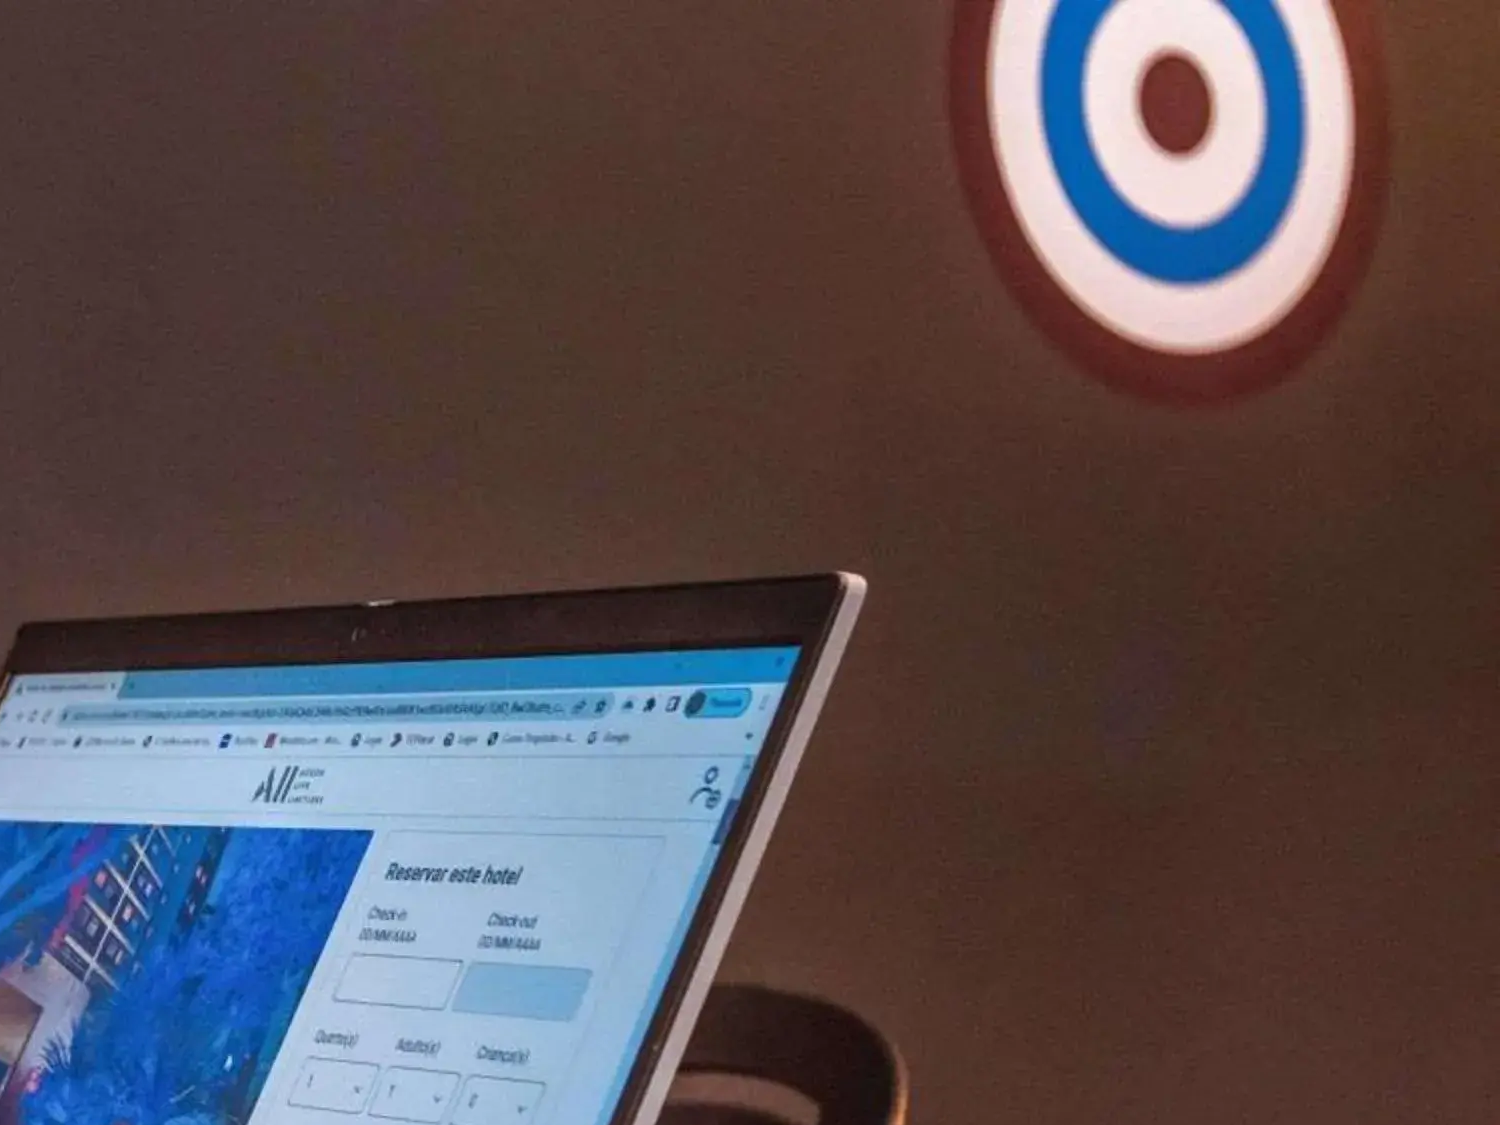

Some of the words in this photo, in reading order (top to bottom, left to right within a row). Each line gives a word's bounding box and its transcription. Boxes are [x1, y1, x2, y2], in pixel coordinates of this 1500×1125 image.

[384, 862, 448, 882] Reservar
[449, 867, 480, 884] este
[482, 866, 523, 885] hotel
